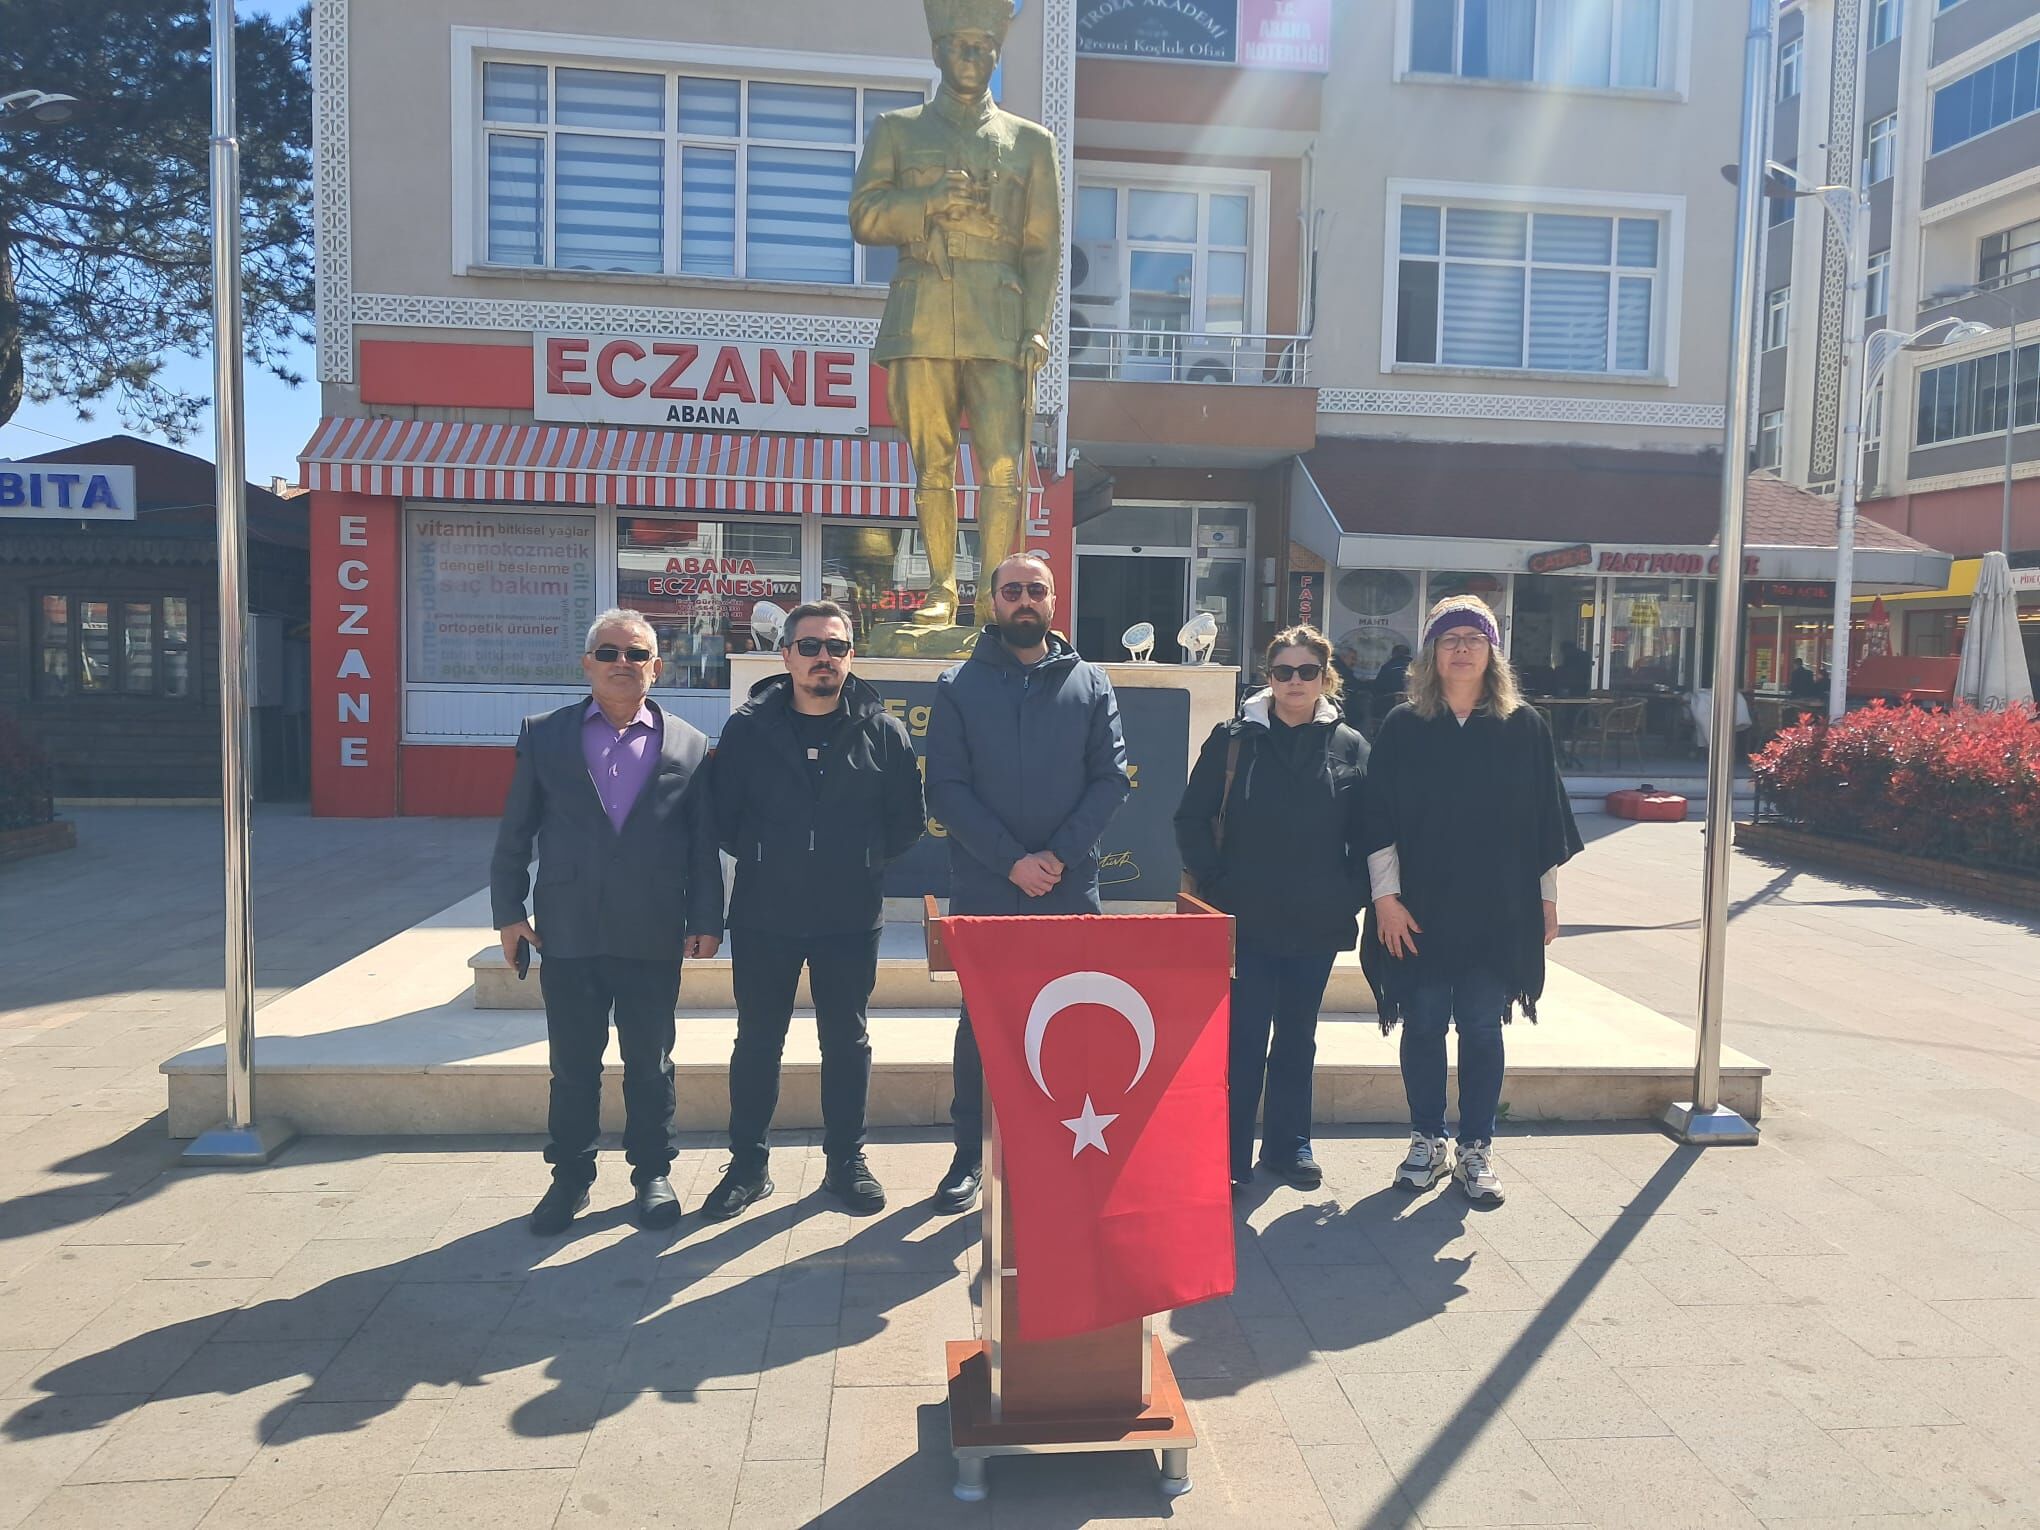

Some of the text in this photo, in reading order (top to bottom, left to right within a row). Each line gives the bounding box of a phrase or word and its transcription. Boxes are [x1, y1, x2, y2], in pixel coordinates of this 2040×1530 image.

[1260, 20, 1311, 40] ABANA
[546, 337, 858, 409] ECZANE
[666, 404, 740, 425] ABANA
[416, 519, 495, 538] vitamin
[498, 522, 592, 539] bitkisel yağlar
[439, 541, 590, 559] dermokozmetik
[439, 559, 570, 575] dengeli beslenme
[665, 557, 756, 575] ABANA
[1598, 551, 1760, 576] FAST FOOD CE
[439, 574, 569, 598] saç bakımı
[1299, 575, 1313, 625] FAST
[438, 621, 559, 636] ortopetik ürünler
[337, 515, 371, 767] ECZANE
[535, 664, 585, 680] sağlığ
